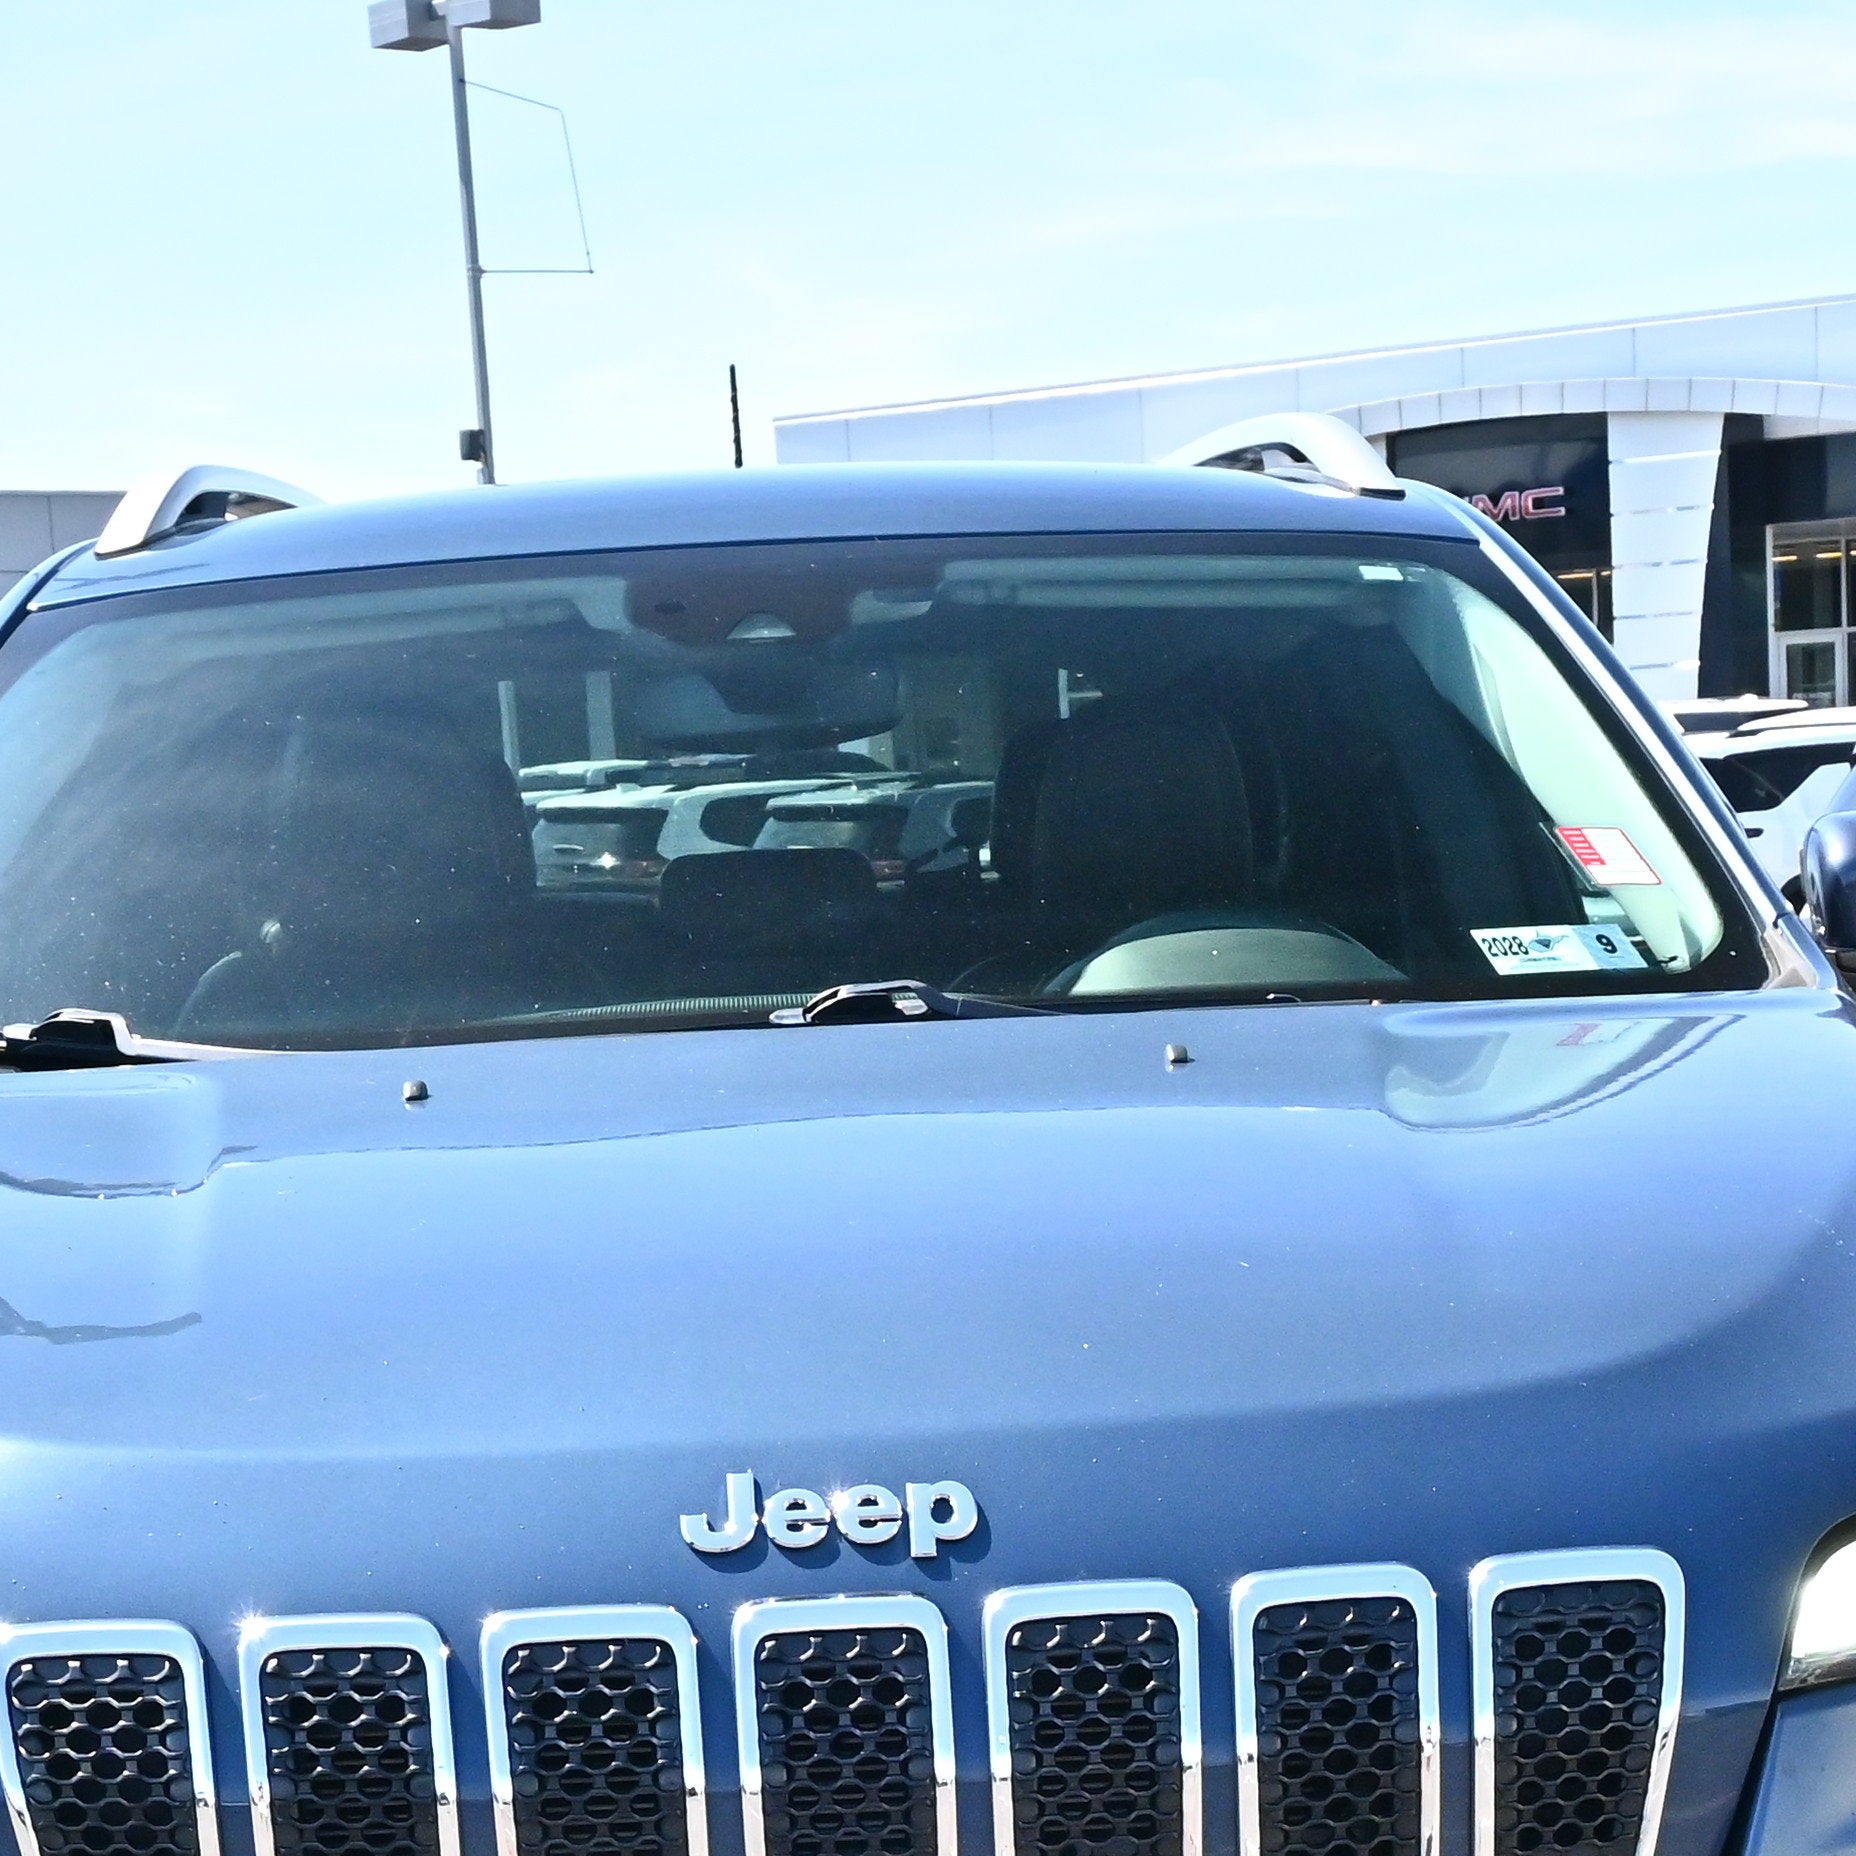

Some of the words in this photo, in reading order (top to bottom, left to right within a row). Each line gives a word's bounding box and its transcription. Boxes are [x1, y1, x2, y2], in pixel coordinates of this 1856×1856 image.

[1464, 486, 1566, 521] MC
[1482, 936, 1529, 957] 2028
[1595, 933, 1618, 954] 9
[679, 1470, 979, 1557] Jeep
